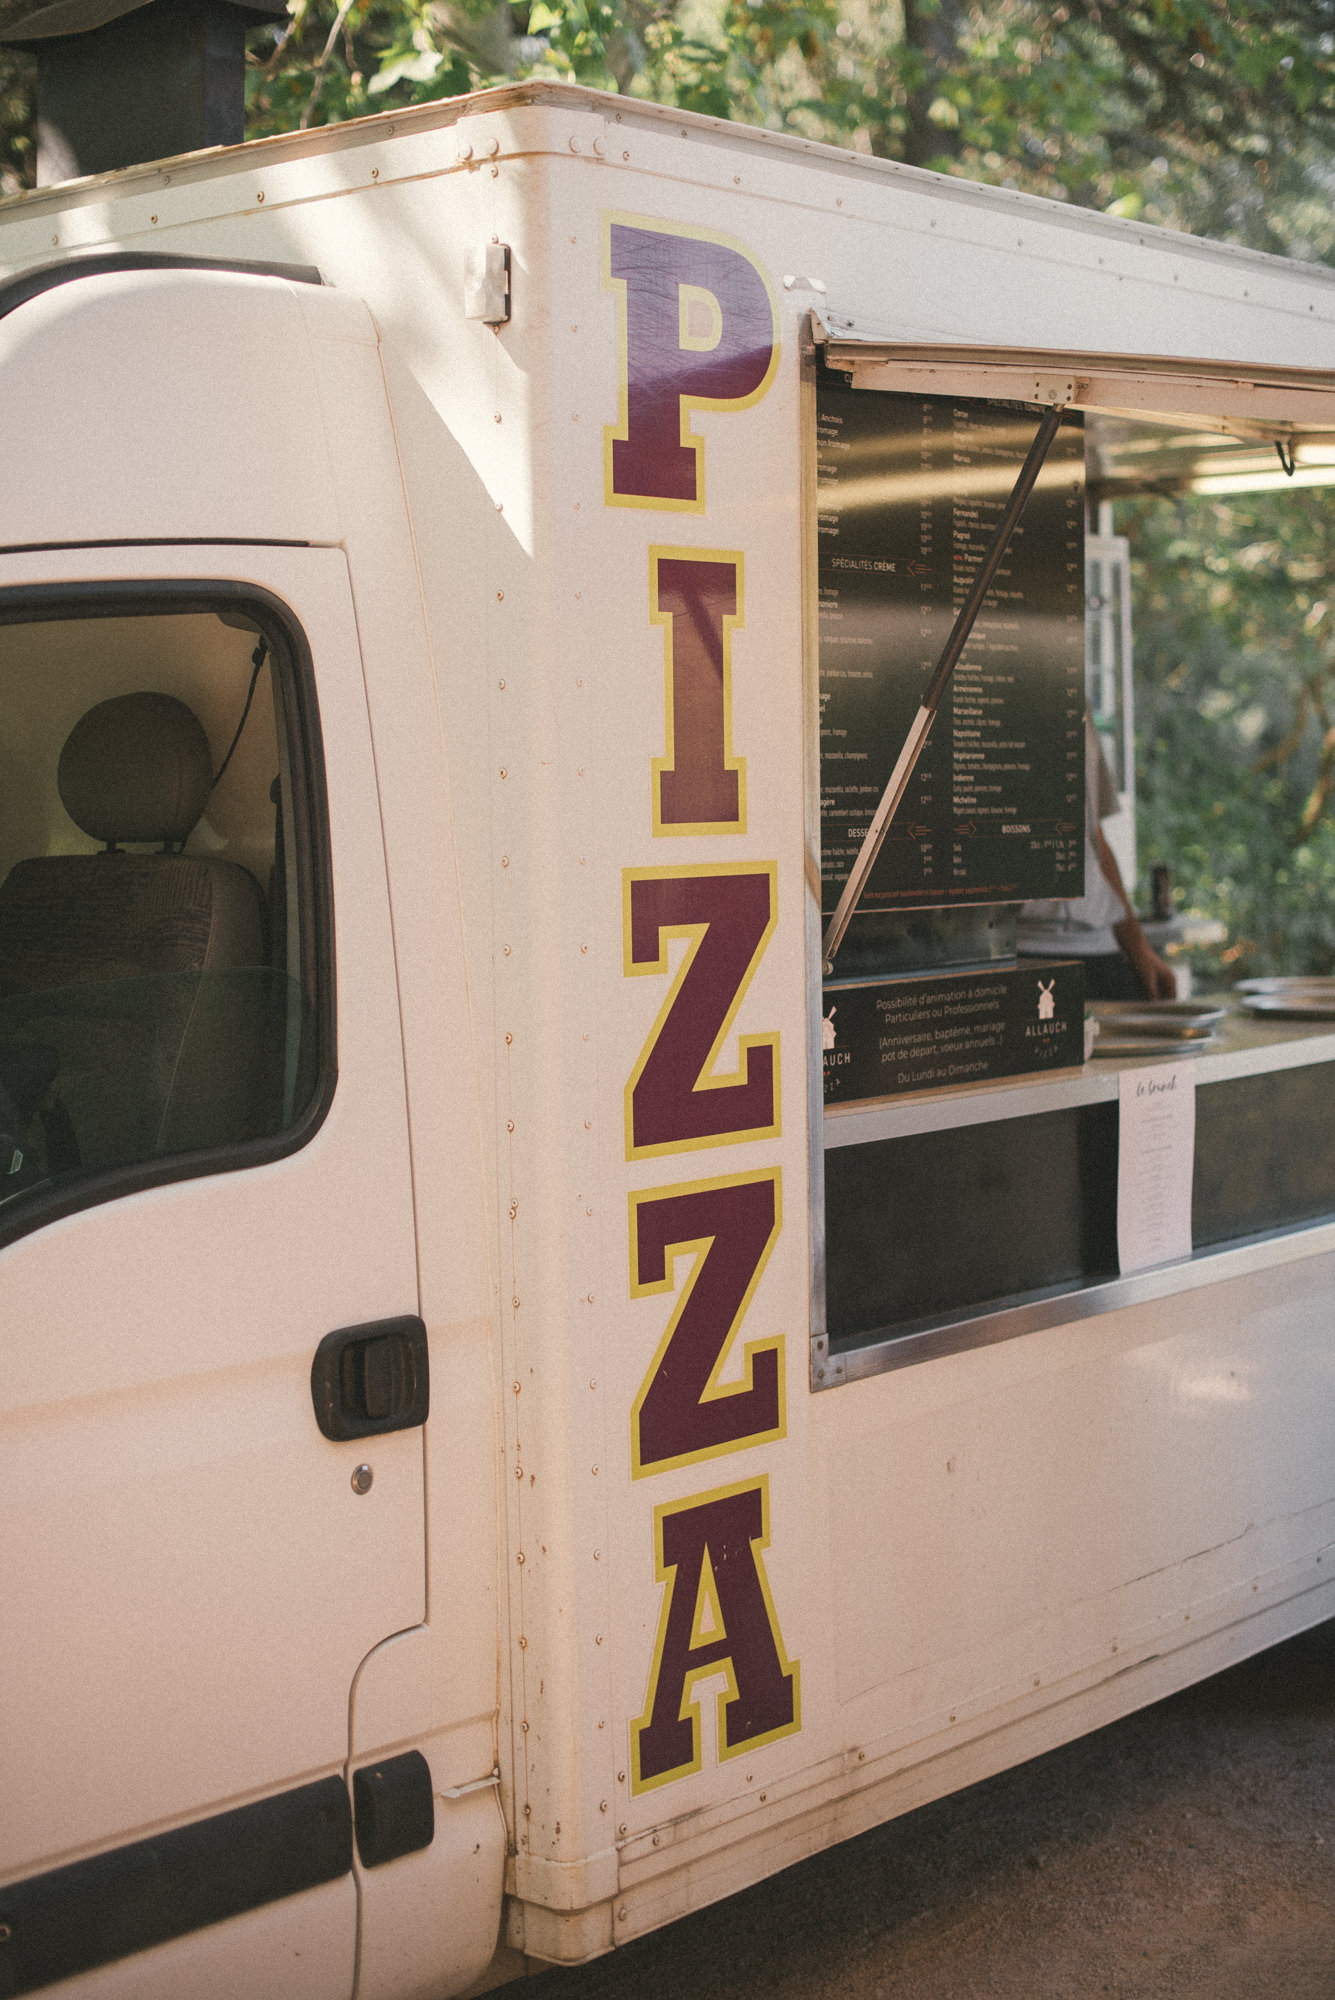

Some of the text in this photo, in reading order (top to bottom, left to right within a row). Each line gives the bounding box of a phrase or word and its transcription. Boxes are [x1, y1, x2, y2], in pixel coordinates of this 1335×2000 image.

[831, 557, 872, 570] SPÉCIALITÉS
[848, 828, 868, 838] DESSE
[1001, 824, 1031, 834] BOISSONS
[600, 209, 802, 1797] PIZZA
[877, 995, 917, 1009] Possibilité
[919, 989, 966, 1004] d'animation
[975, 984, 1007, 997] domicile
[885, 1000, 1000, 1024] Particuliers ou Professionnels
[1025, 1022, 1067, 1037] ALLAUCH
[823, 1051, 851, 1066] AUCH
[882, 1051, 896, 1064] pot
[897, 1048, 908, 1059] de
[897, 1060, 988, 1084] Du Lundi au Dimanche
